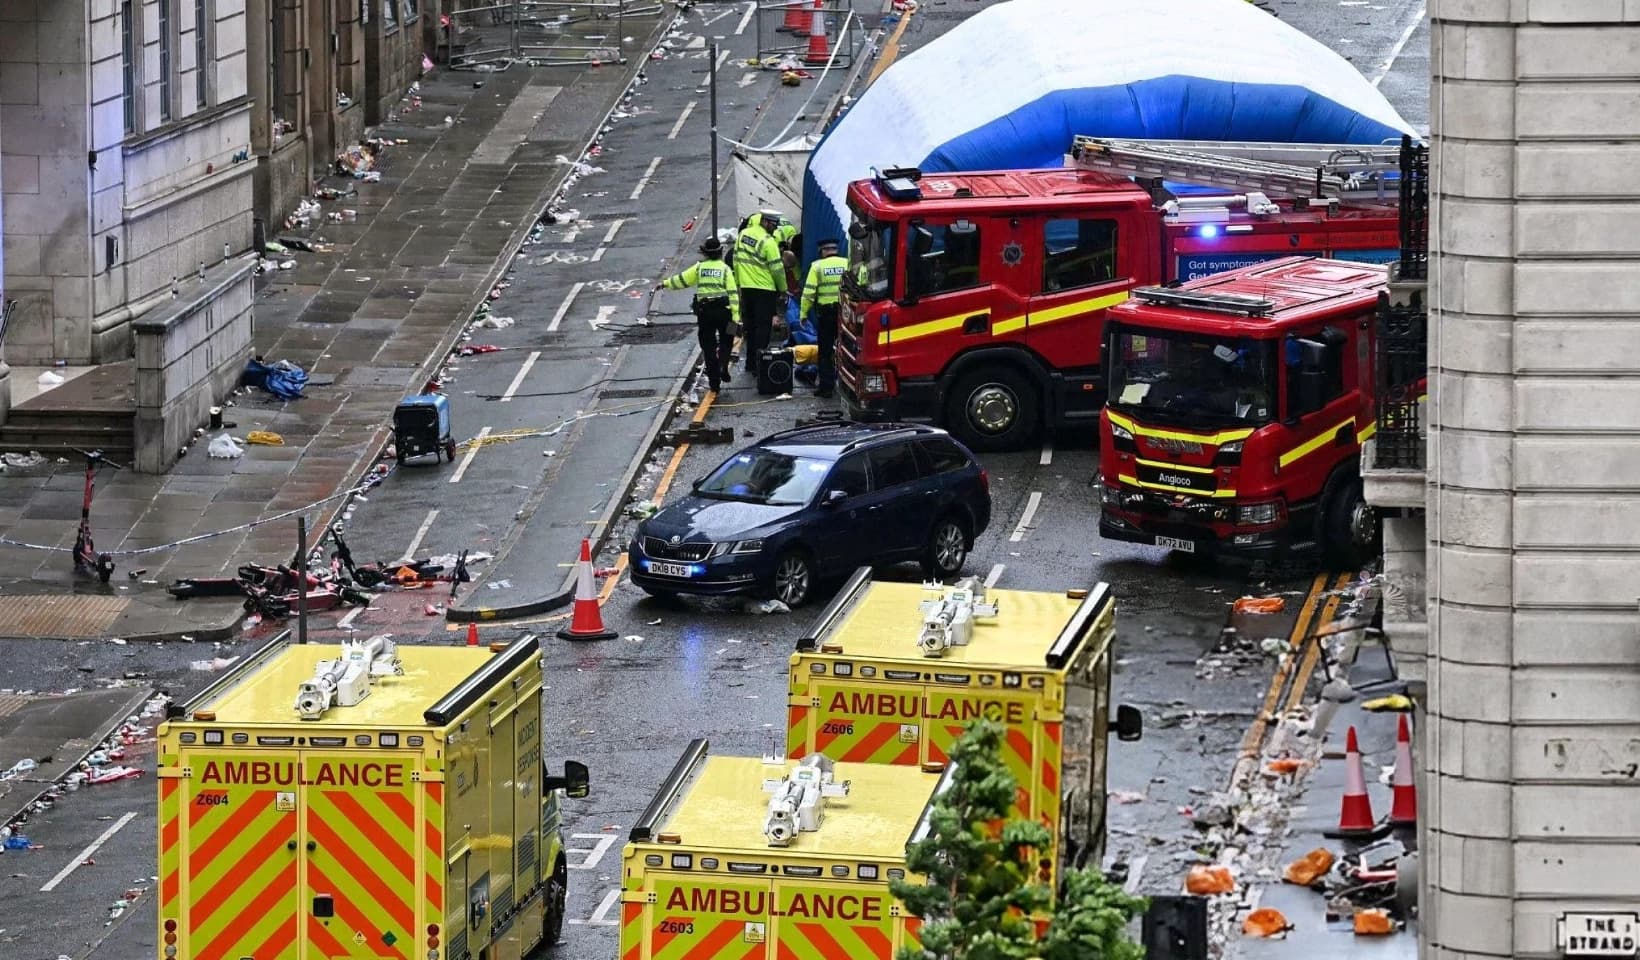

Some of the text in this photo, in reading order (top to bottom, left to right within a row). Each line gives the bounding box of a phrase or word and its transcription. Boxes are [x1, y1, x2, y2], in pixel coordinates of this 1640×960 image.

[824, 267, 844, 275] POLICE
[1188, 260, 1206, 270] Got
[701, 269, 721, 277] POLICE
[1159, 472, 1191, 486] Angloco
[1158, 537, 1192, 550] DK72 AVU
[652, 564, 686, 576] DK18 CYS
[828, 691, 1025, 725] AMBULANCE
[823, 722, 854, 736] Z606
[201, 761, 404, 788] AMBULANCE
[196, 792, 228, 806] Z604
[666, 886, 882, 921] AMBULANCE
[660, 920, 694, 935] Z603
[1585, 918, 1616, 932] THE
